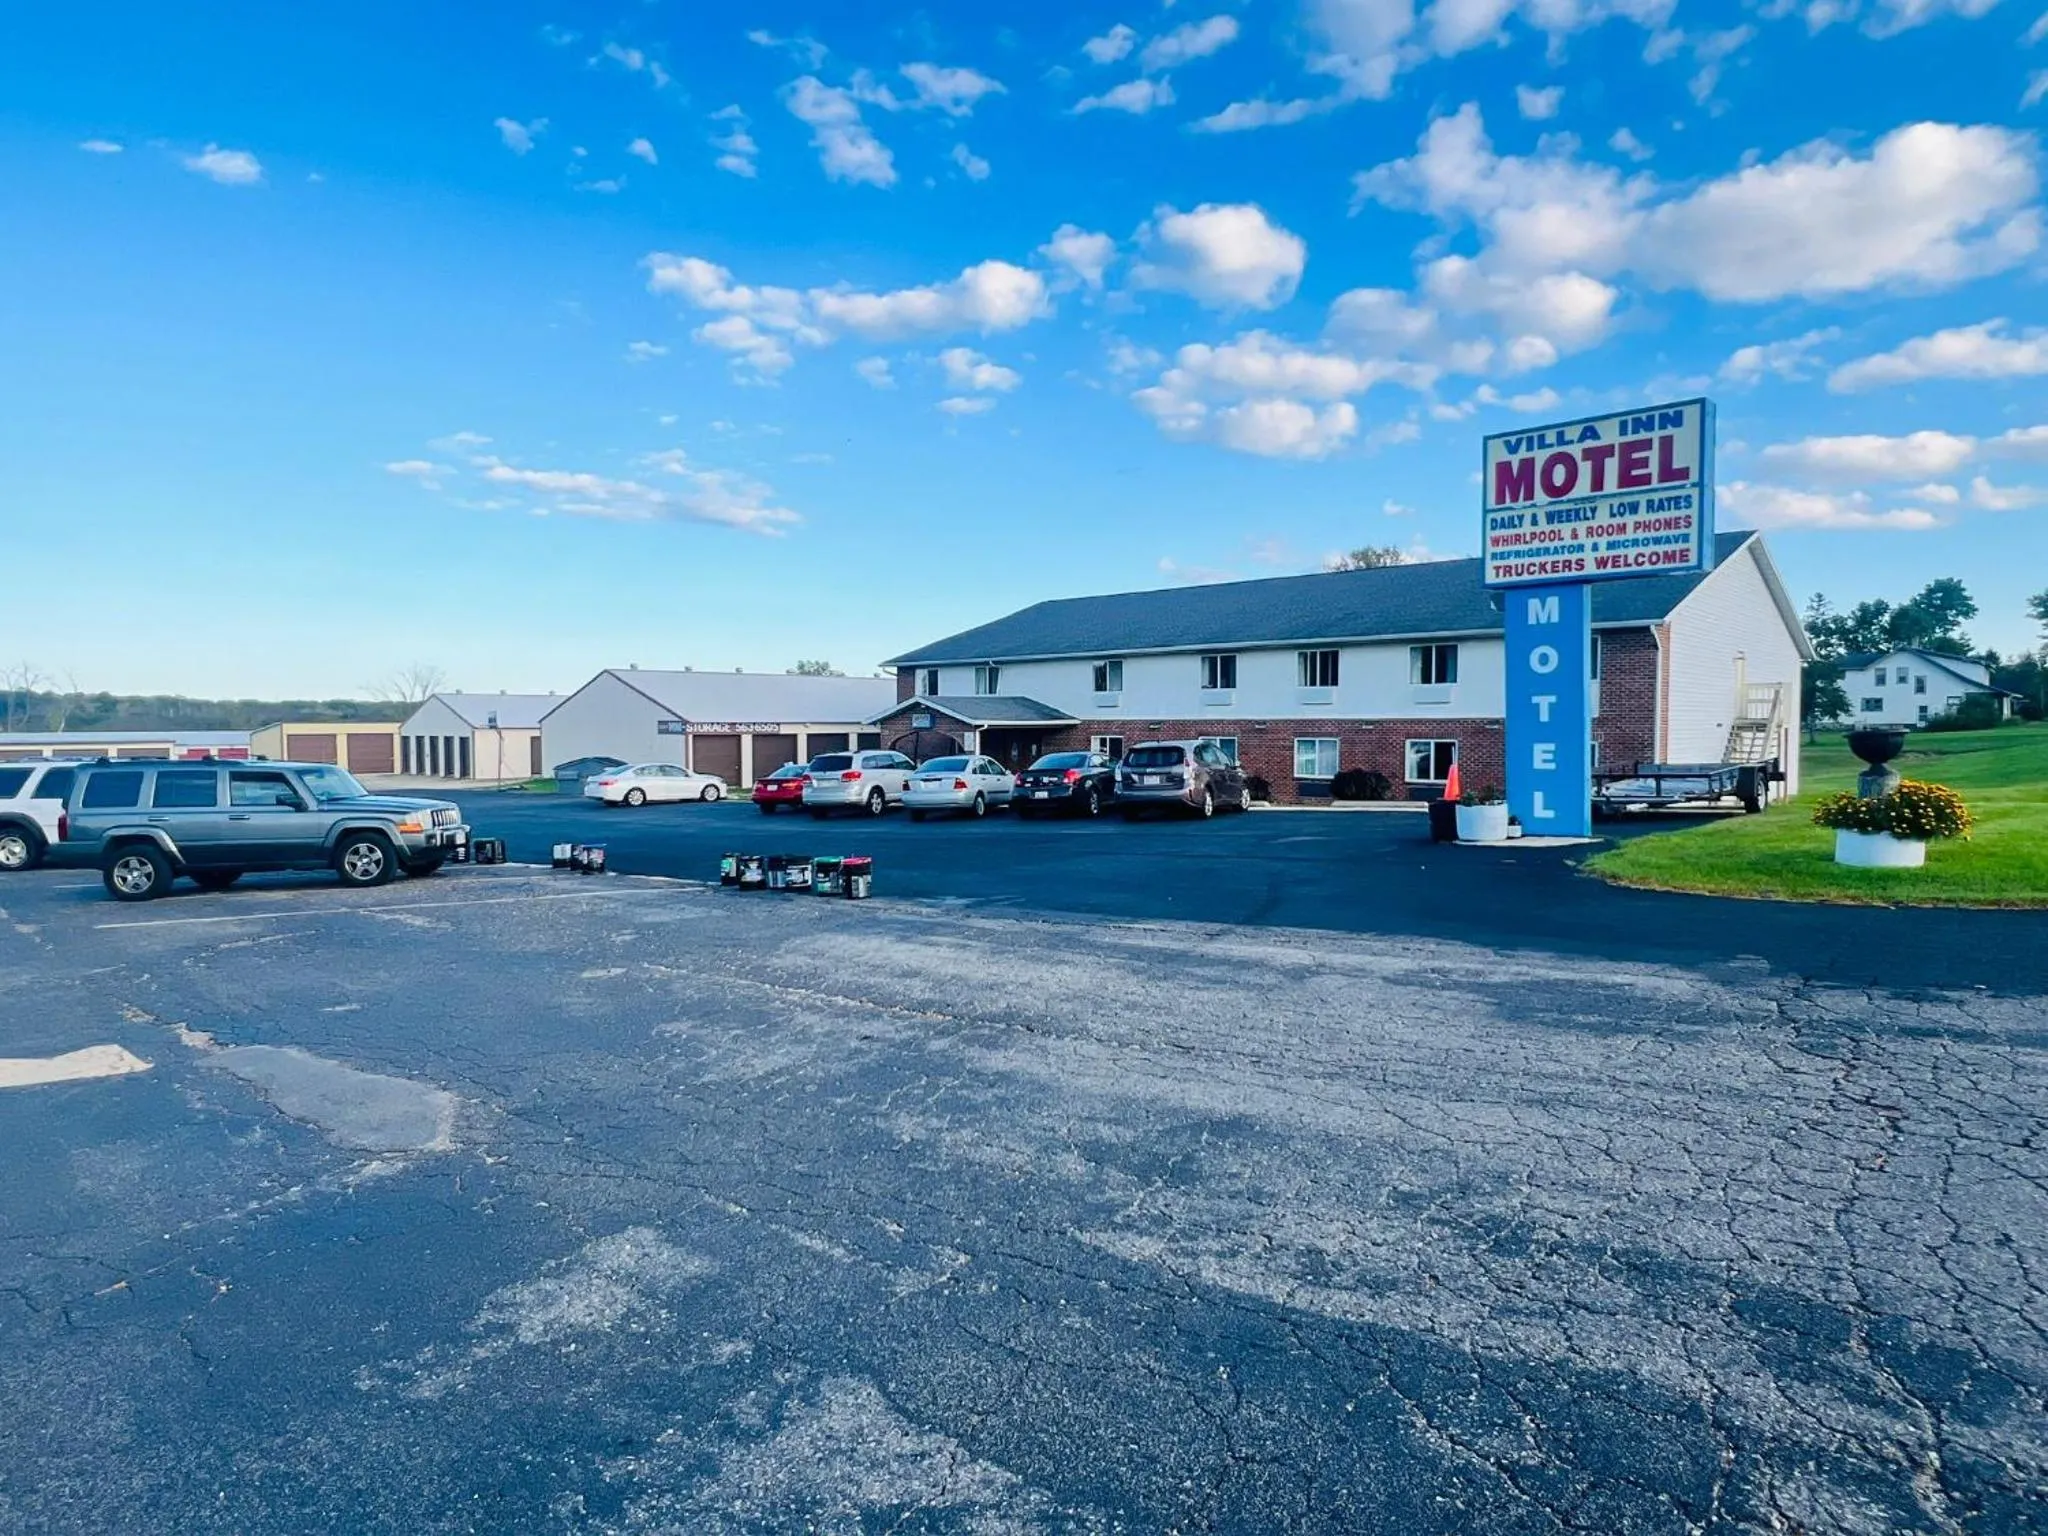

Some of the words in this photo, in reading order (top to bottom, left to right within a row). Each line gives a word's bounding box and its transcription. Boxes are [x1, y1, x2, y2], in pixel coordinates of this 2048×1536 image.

[1503, 425, 1600, 455] VILLA
[1619, 409, 1684, 436] INN
[1494, 435, 1690, 506] MOTEL
[1490, 514, 1525, 531] DAILY
[1531, 513, 1538, 527] &
[1545, 505, 1598, 525] WEEKLY
[1609, 501, 1640, 518] LOW
[1646, 494, 1692, 514] RATES
[1490, 529, 1565, 547] WHIRLPOOL
[1571, 527, 1579, 540] &
[1586, 522, 1627, 539] ROOM
[1633, 514, 1692, 533] PHONES
[1490, 543, 1585, 561] REFRIGERATOR
[1591, 542, 1599, 553] &
[1606, 533, 1691, 550] MICROWAVE
[1493, 558, 1585, 578] TRUCKERS
[1594, 549, 1691, 571] WELCOME
[1527, 596, 1560, 819] MOTEL
